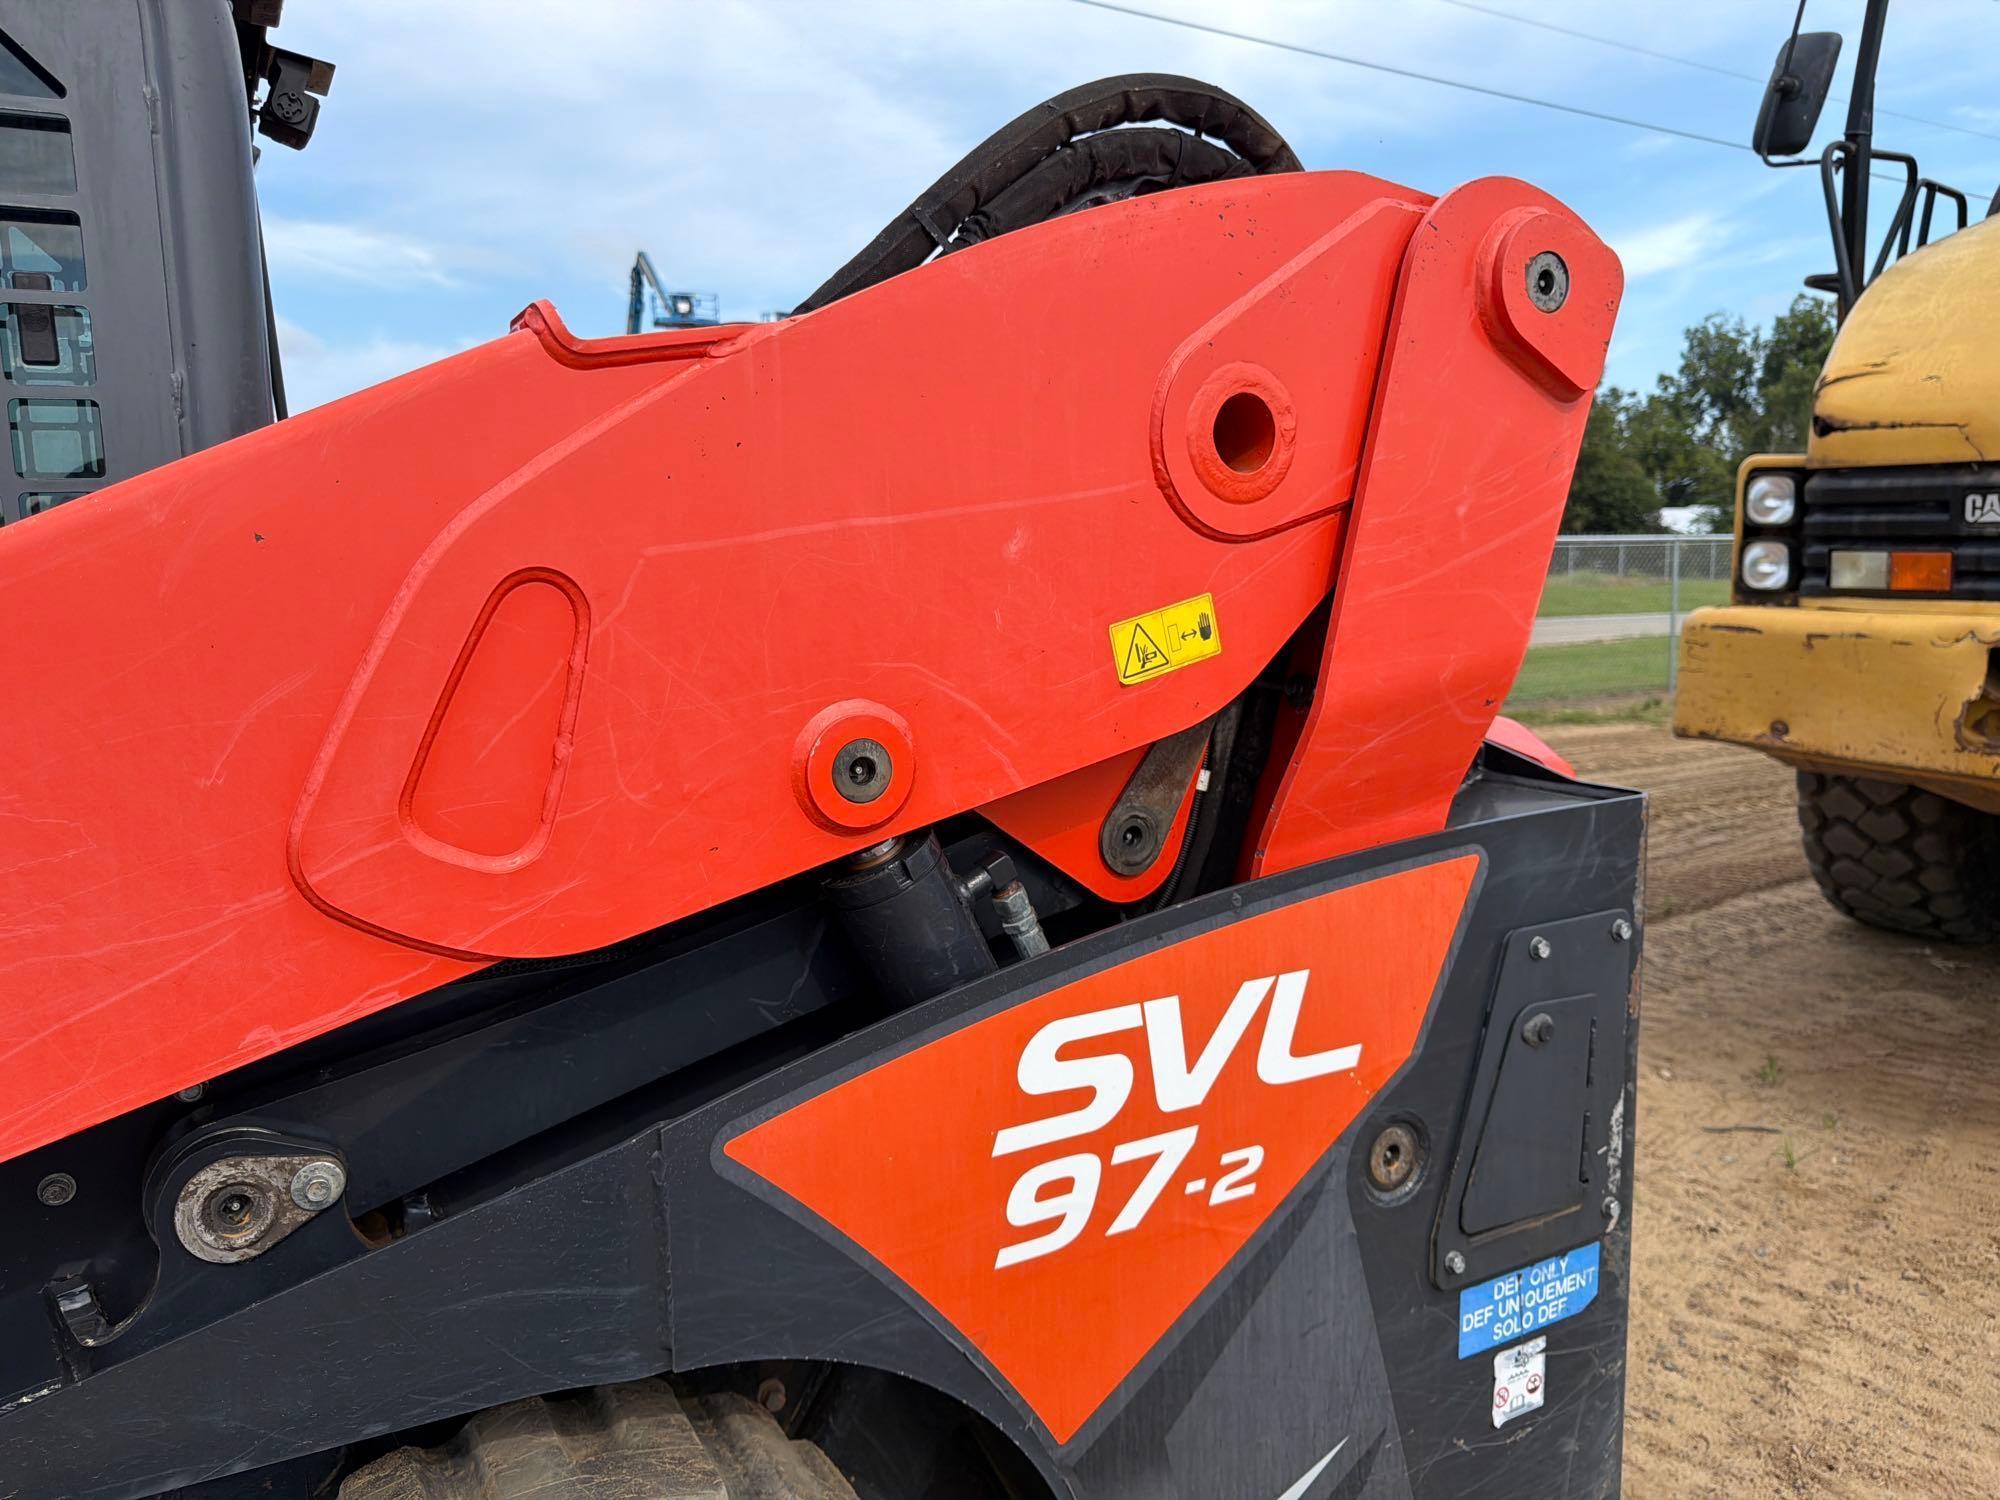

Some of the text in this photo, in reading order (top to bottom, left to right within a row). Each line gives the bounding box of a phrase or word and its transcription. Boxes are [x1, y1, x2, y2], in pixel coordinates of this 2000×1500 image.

[992, 969, 1362, 1158] SVL
[994, 1125, 1264, 1270] 97-2
[1462, 1267, 1596, 1333] DEF UNIQUEMENT
[1530, 1257, 1568, 1286] ONLY
[1493, 1297, 1568, 1341] SOLO DEF
